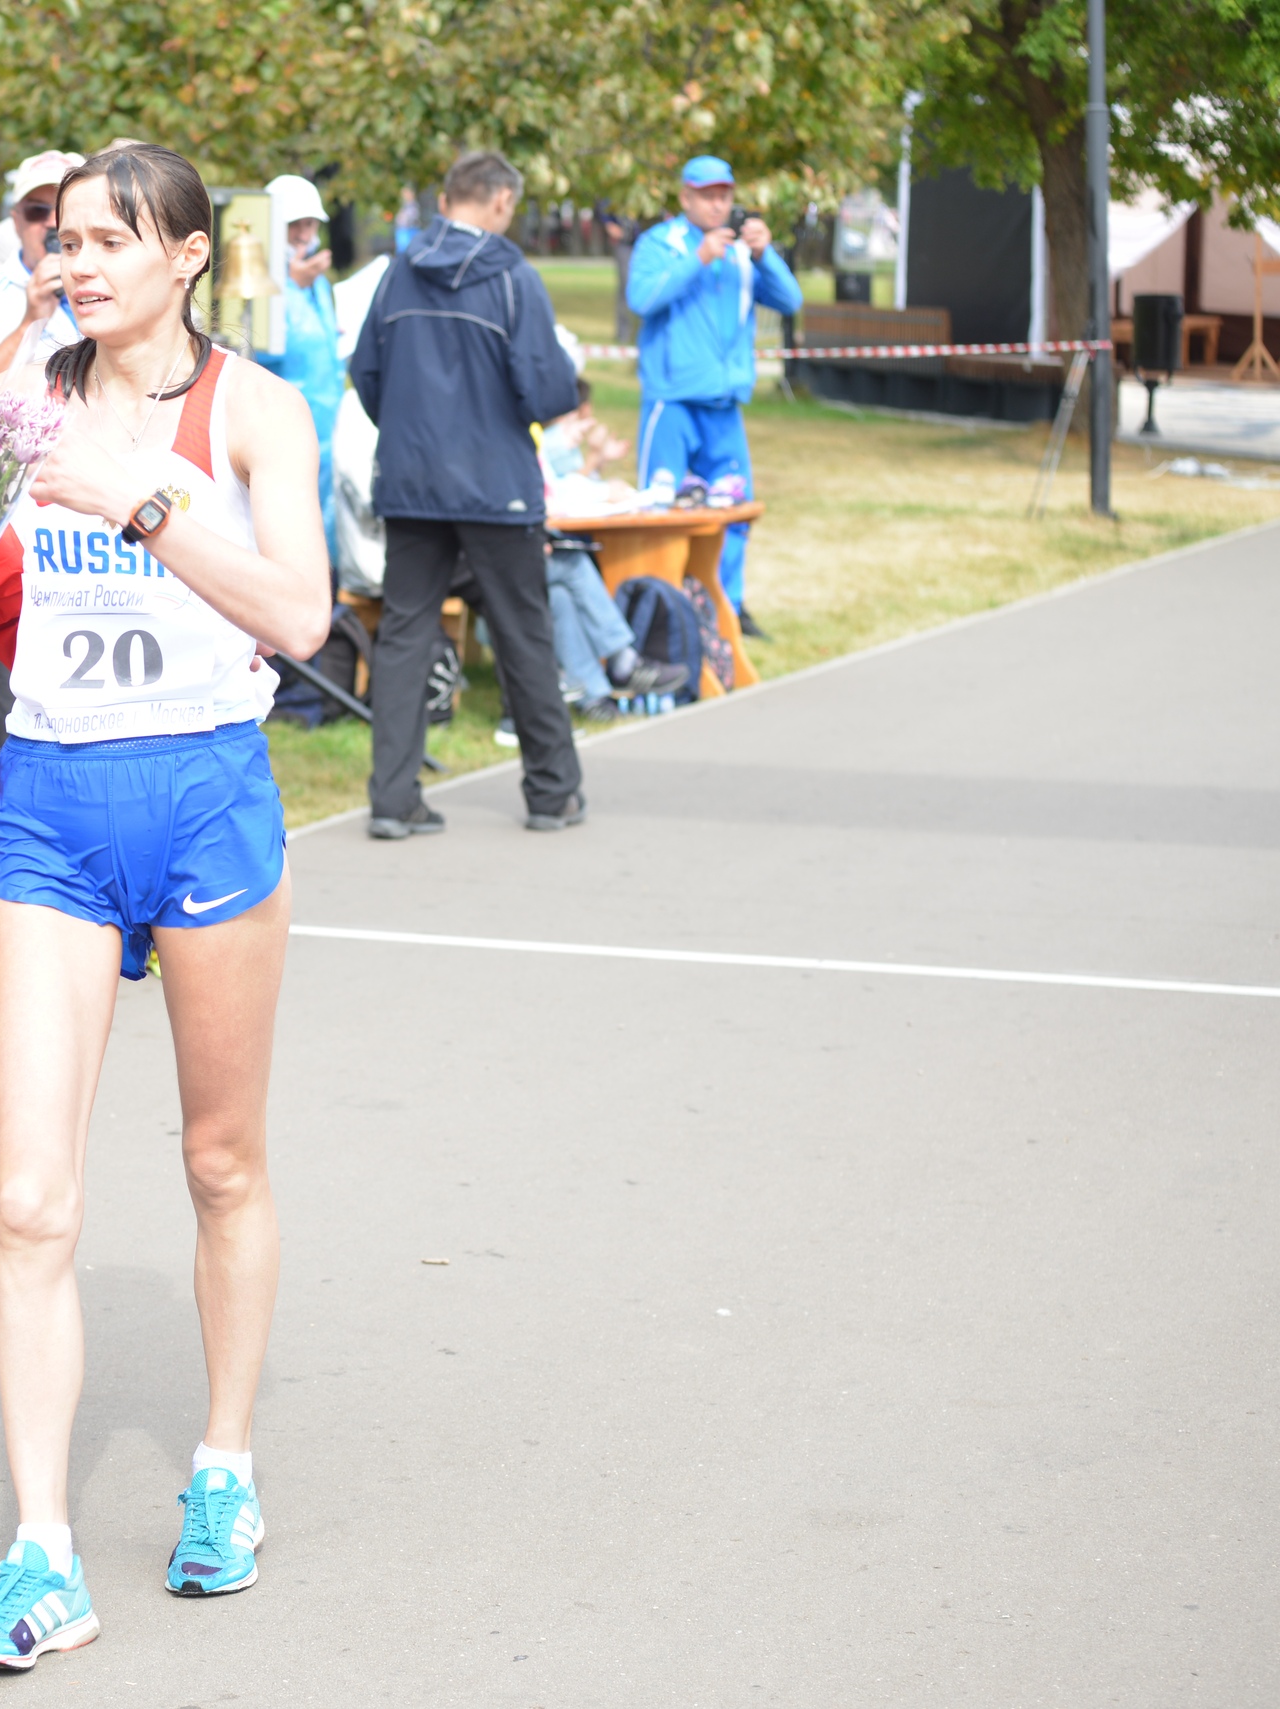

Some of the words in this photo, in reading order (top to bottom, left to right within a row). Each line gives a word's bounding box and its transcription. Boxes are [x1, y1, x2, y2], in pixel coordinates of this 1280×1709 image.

[33, 528, 178, 578] RUSSI
[30, 584, 90, 607] Чемпионат
[94, 584, 144, 607] России
[59, 629, 163, 689] 20
